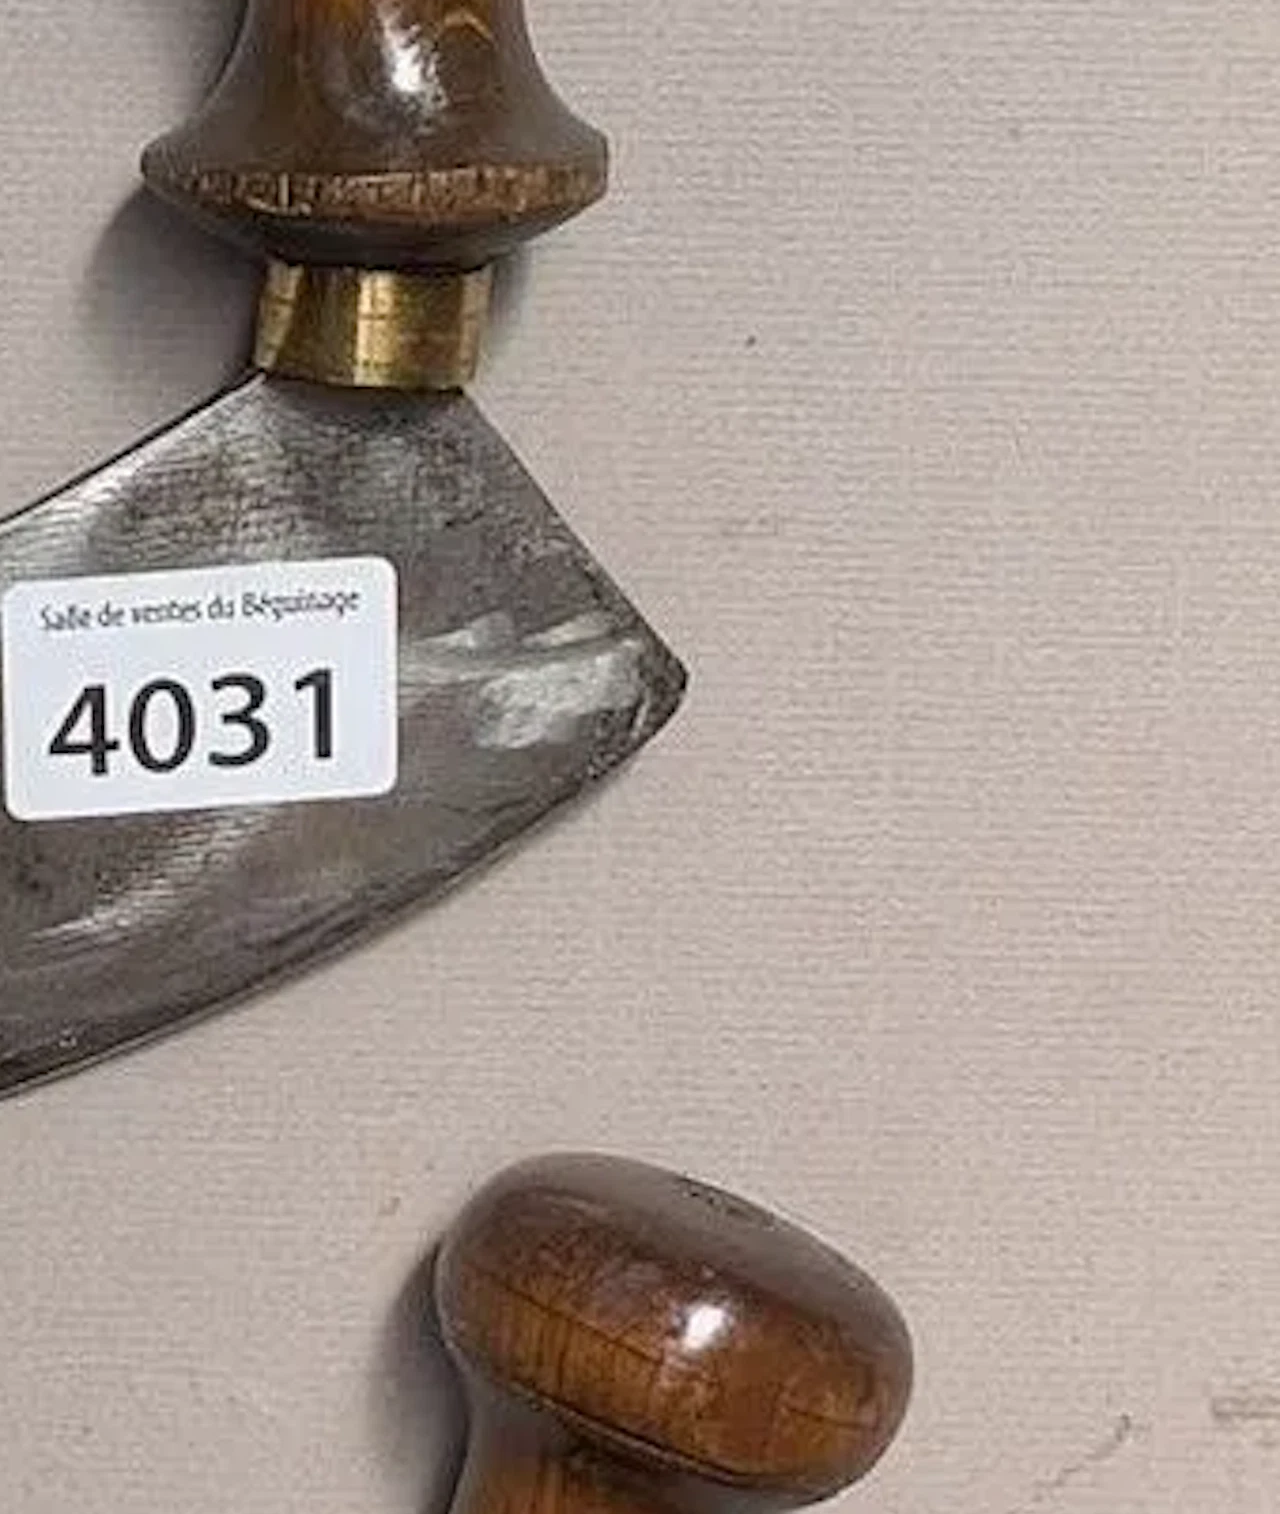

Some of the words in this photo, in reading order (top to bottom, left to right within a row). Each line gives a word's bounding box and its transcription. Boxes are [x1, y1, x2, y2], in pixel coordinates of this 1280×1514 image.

[39, 604, 92, 632] Salle
[97, 600, 125, 628] de
[208, 592, 236, 620] du
[49, 666, 334, 778] 4031
